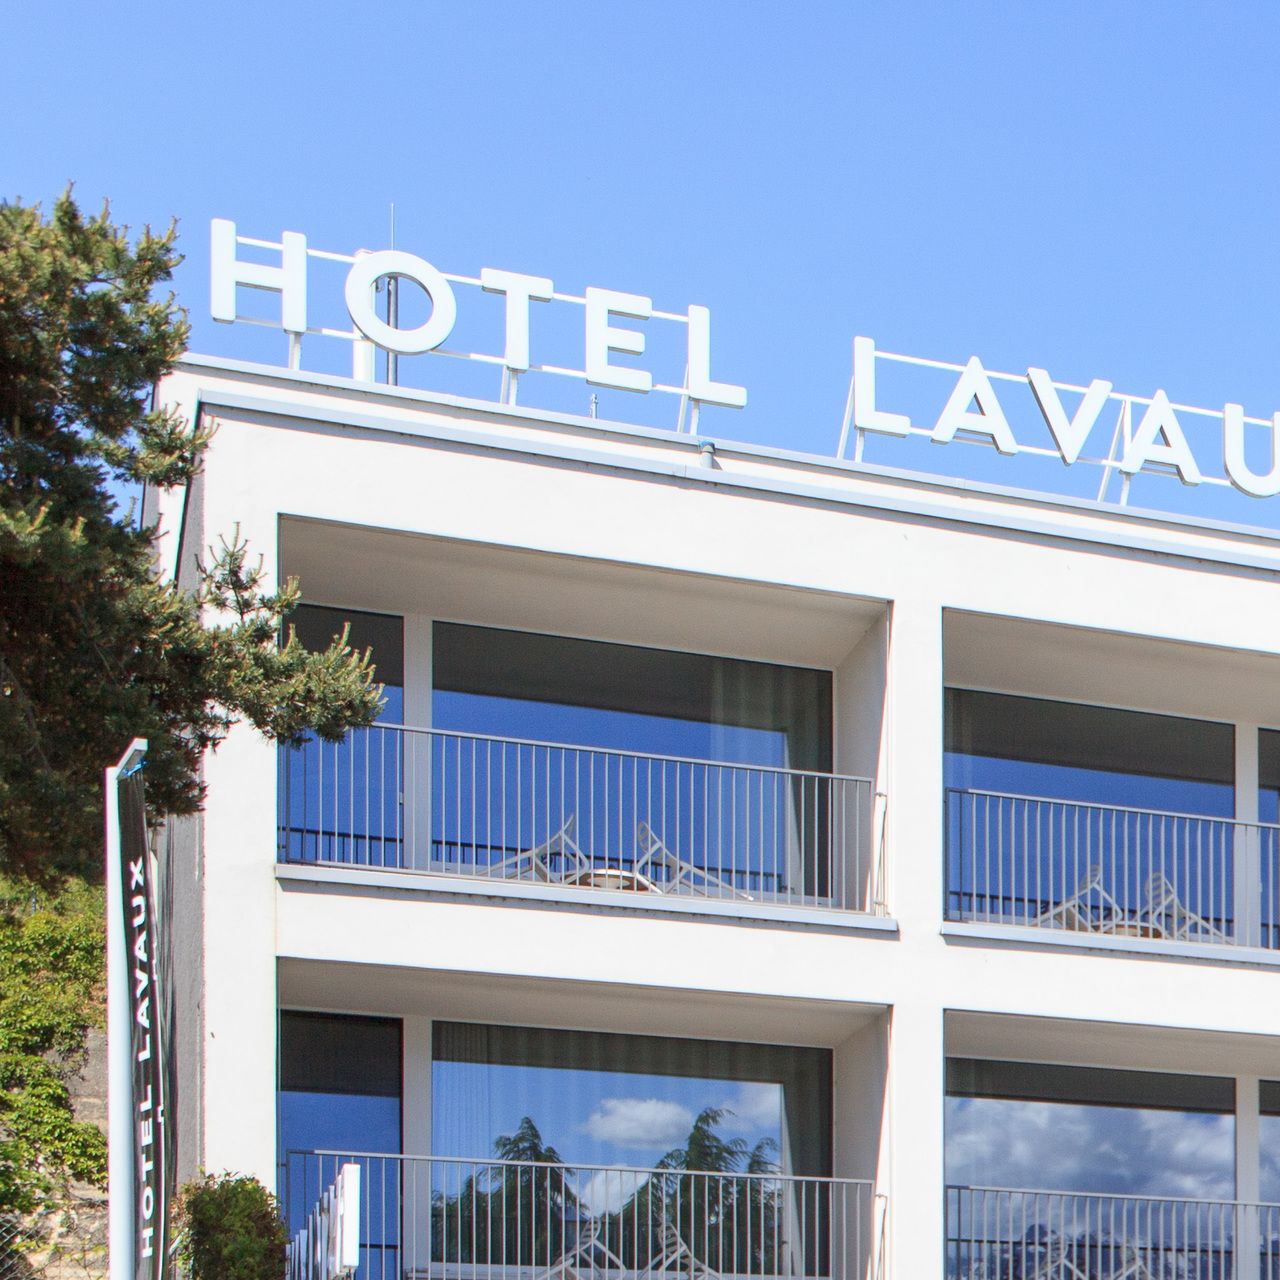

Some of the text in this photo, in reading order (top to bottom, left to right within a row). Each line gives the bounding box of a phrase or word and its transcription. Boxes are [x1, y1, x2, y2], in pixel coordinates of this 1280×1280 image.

[210, 218, 747, 410] HOTEL
[129, 856, 153, 1259] HOTEL LAVAUX
